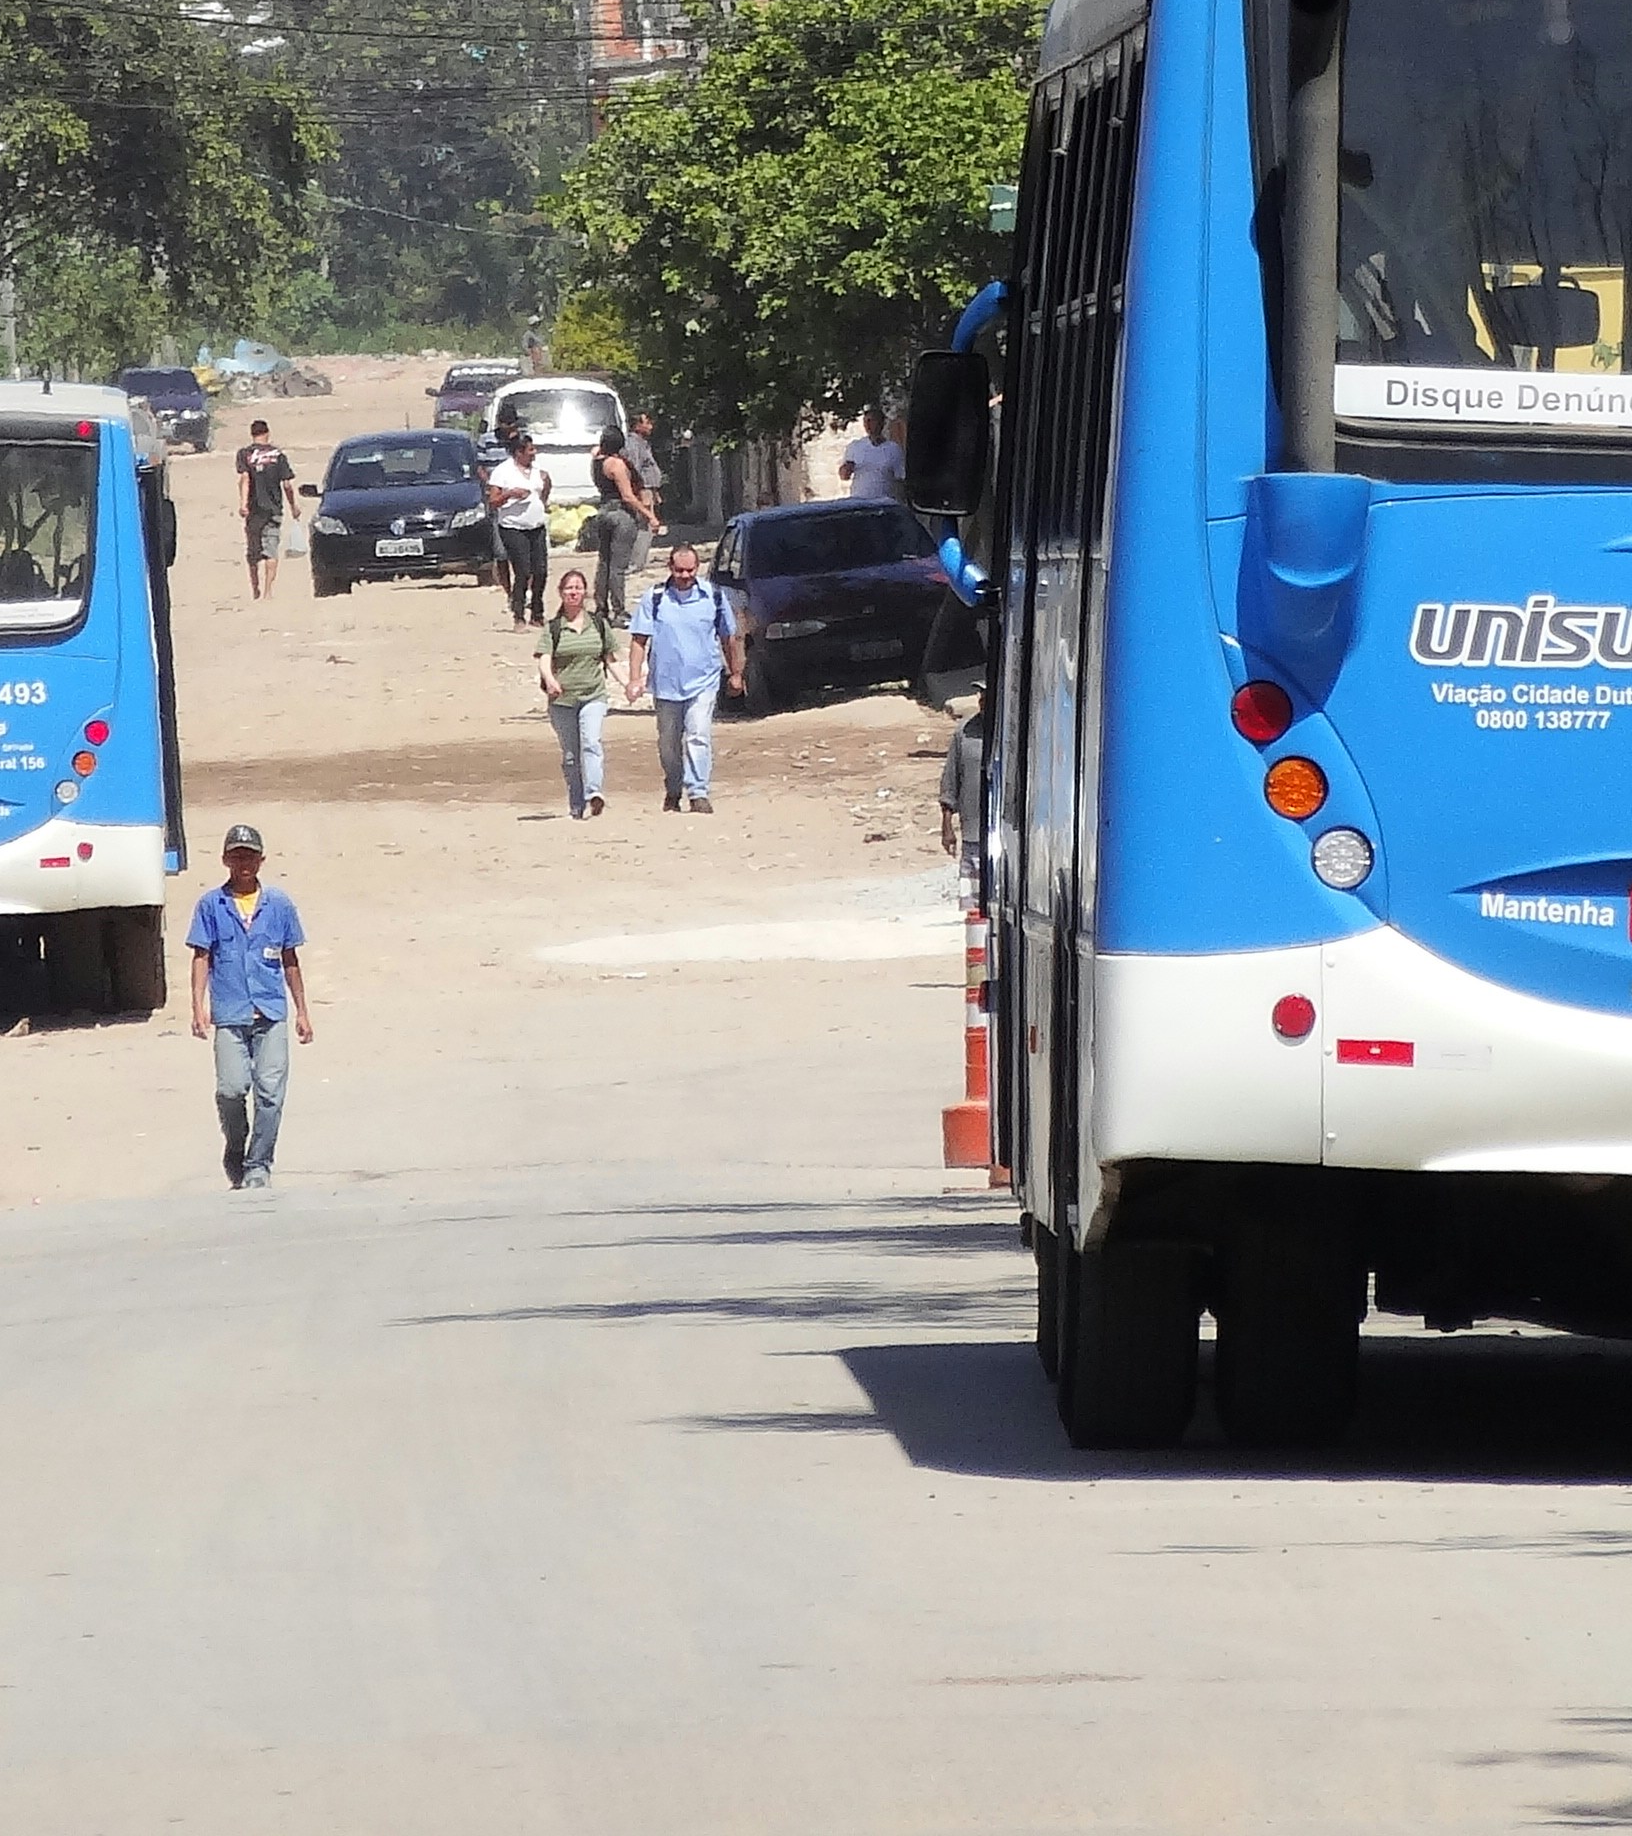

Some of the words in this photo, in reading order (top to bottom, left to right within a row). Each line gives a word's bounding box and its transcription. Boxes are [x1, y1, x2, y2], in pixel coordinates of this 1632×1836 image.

[1385, 379, 1504, 414] Disque
[1431, 683, 1507, 707] Viação
[1511, 684, 1590, 705] Cidade
[1476, 710, 1528, 729] 0800
[1534, 710, 1611, 730] 138777
[20, 755, 46, 770] 156
[1480, 892, 1616, 927] Mantenha
